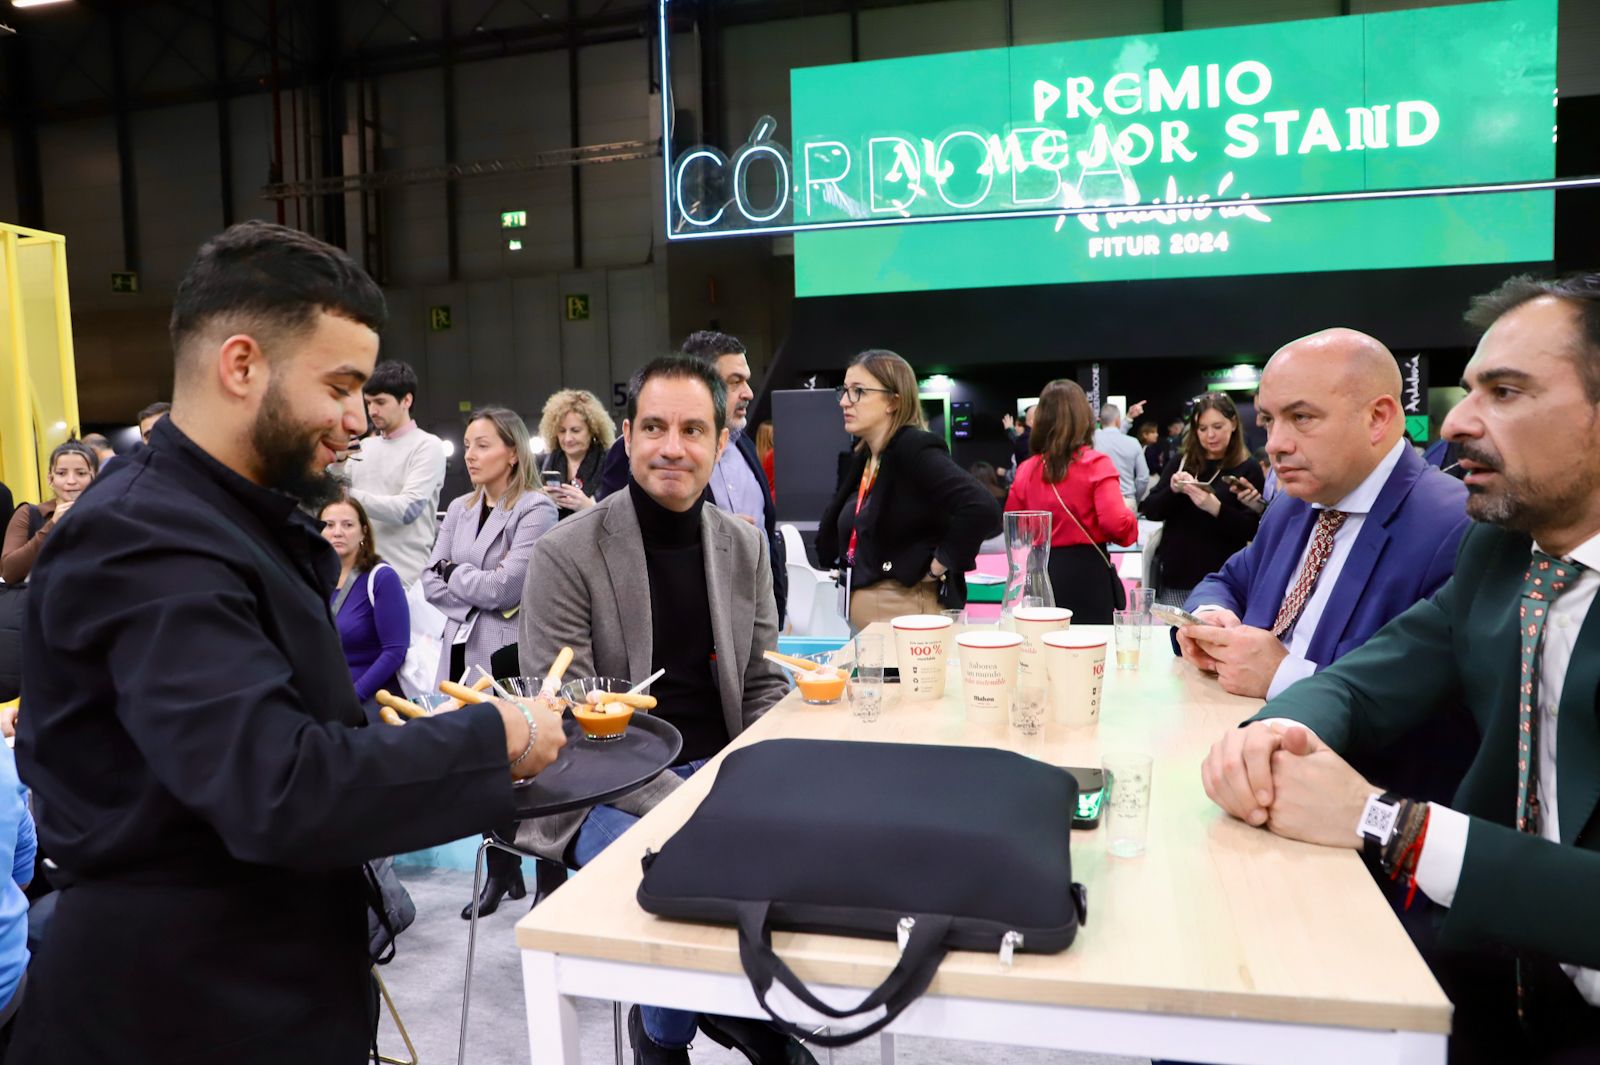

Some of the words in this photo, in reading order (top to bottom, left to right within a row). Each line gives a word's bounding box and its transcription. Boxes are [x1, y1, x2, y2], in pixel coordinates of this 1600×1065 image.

[1033, 60, 1272, 121] PREMIO
[976, 120, 1198, 173] MEJOR
[1223, 100, 1440, 159] STAND
[675, 121, 1134, 227] CÓRDOBA
[1088, 235, 1160, 258] FITUR
[1169, 231, 1229, 255] 2024
[614, 383, 627, 407] 5
